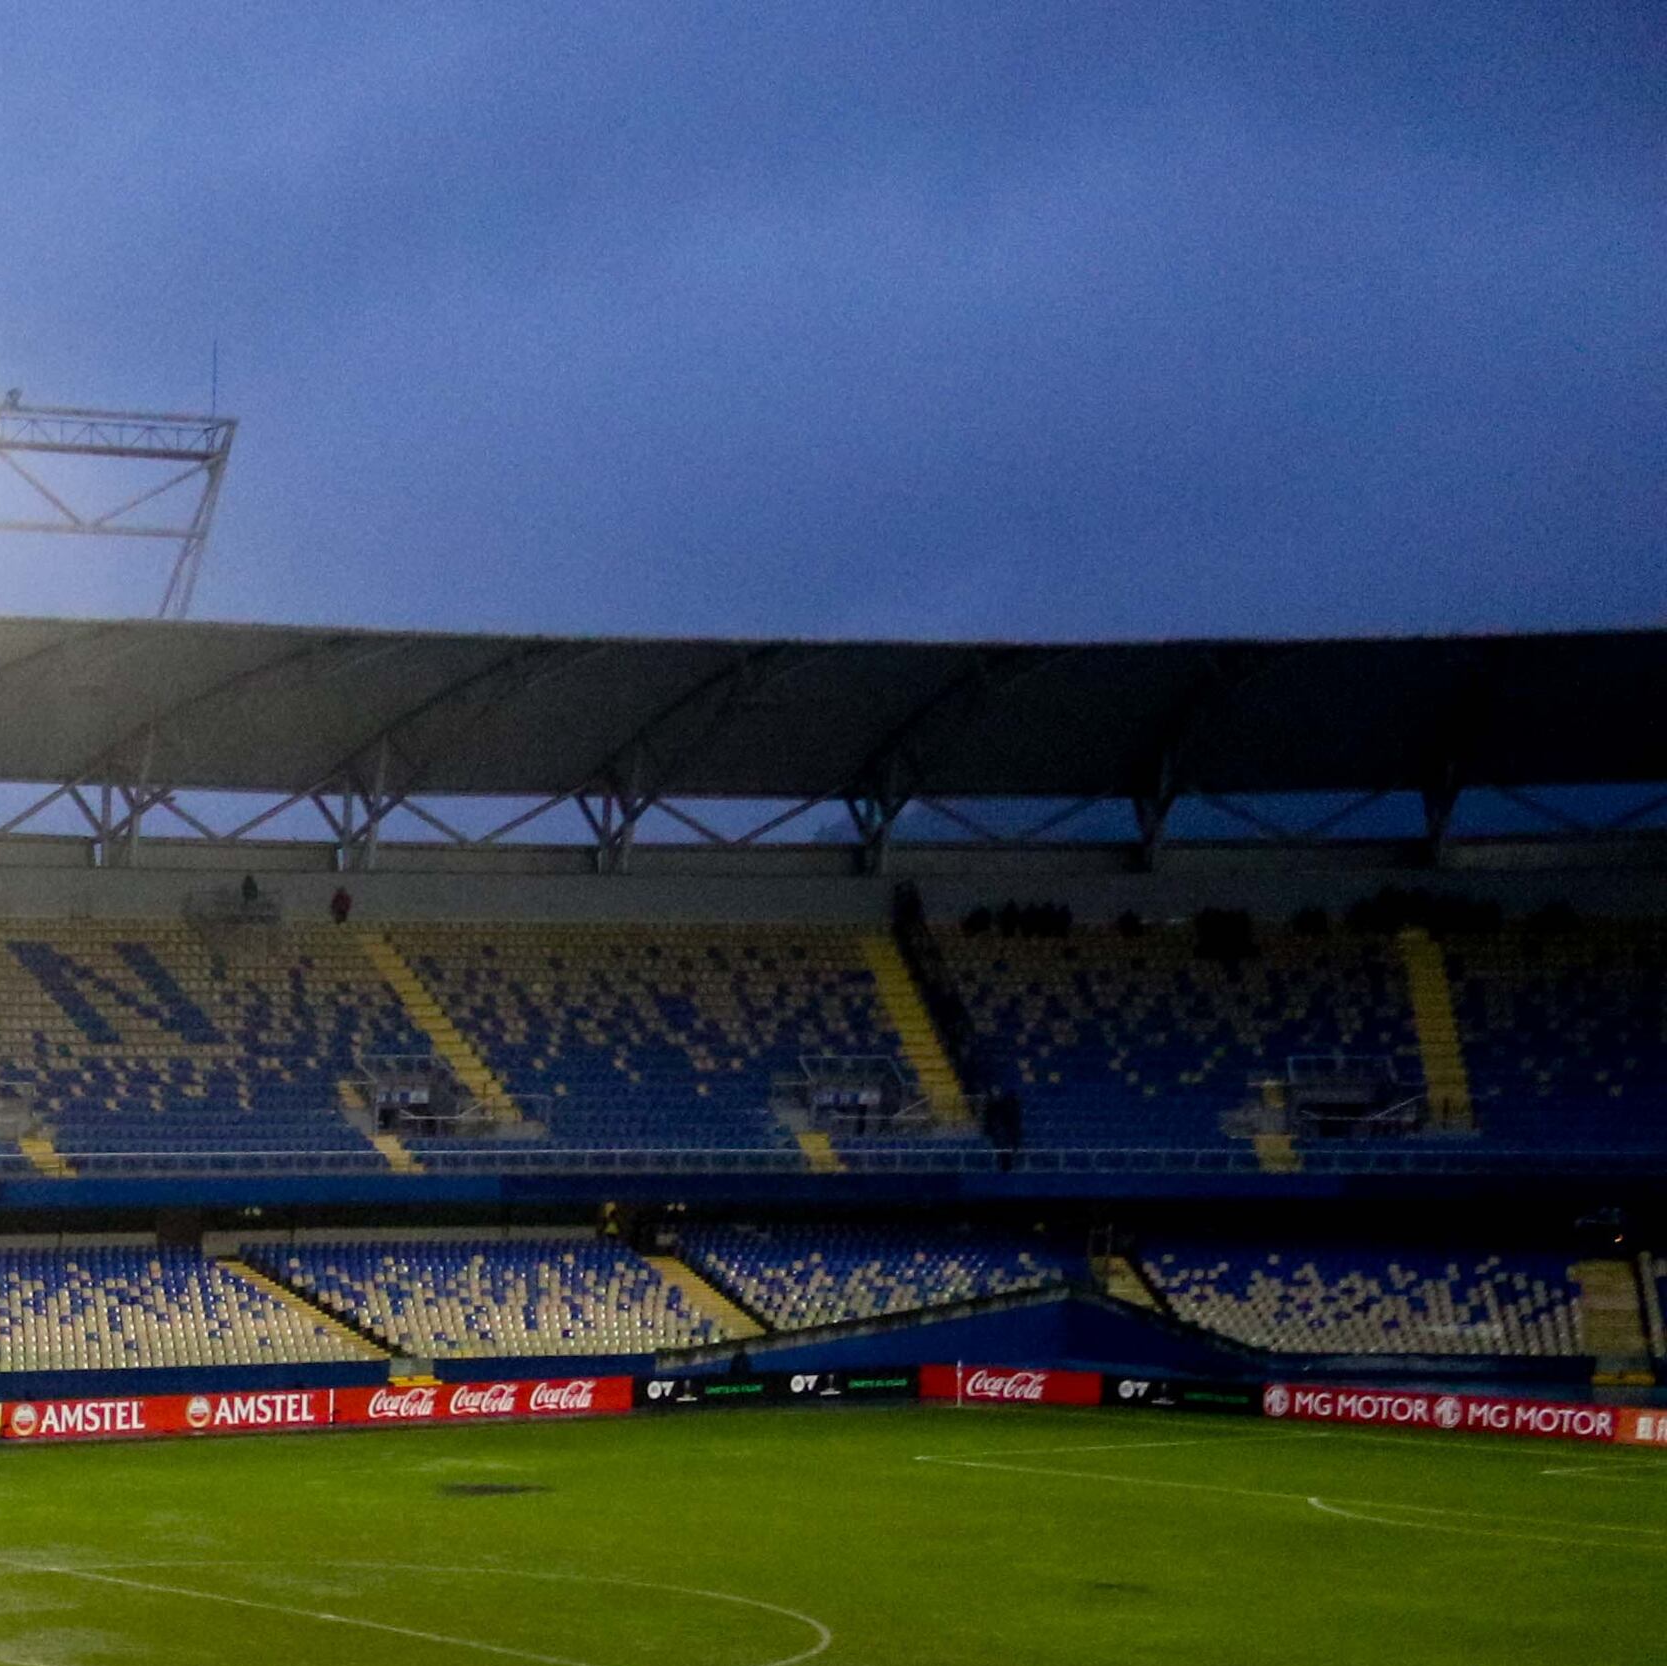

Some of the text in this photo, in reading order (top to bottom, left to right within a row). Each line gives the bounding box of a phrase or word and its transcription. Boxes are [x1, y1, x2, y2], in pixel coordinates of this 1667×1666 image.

[368, 1381, 597, 1418] Coca-Cola Coca-Cola Coca-Cola
[967, 1370, 1049, 1400] Coca-Cola
[40, 1402, 145, 1433] AMSTEL
[213, 1394, 315, 1425] AMSTEL
[1295, 1392, 1333, 1416] MG
[1337, 1394, 1430, 1423] MOTOR
[1468, 1403, 1510, 1428] MG
[1514, 1406, 1613, 1437] MOTOR
